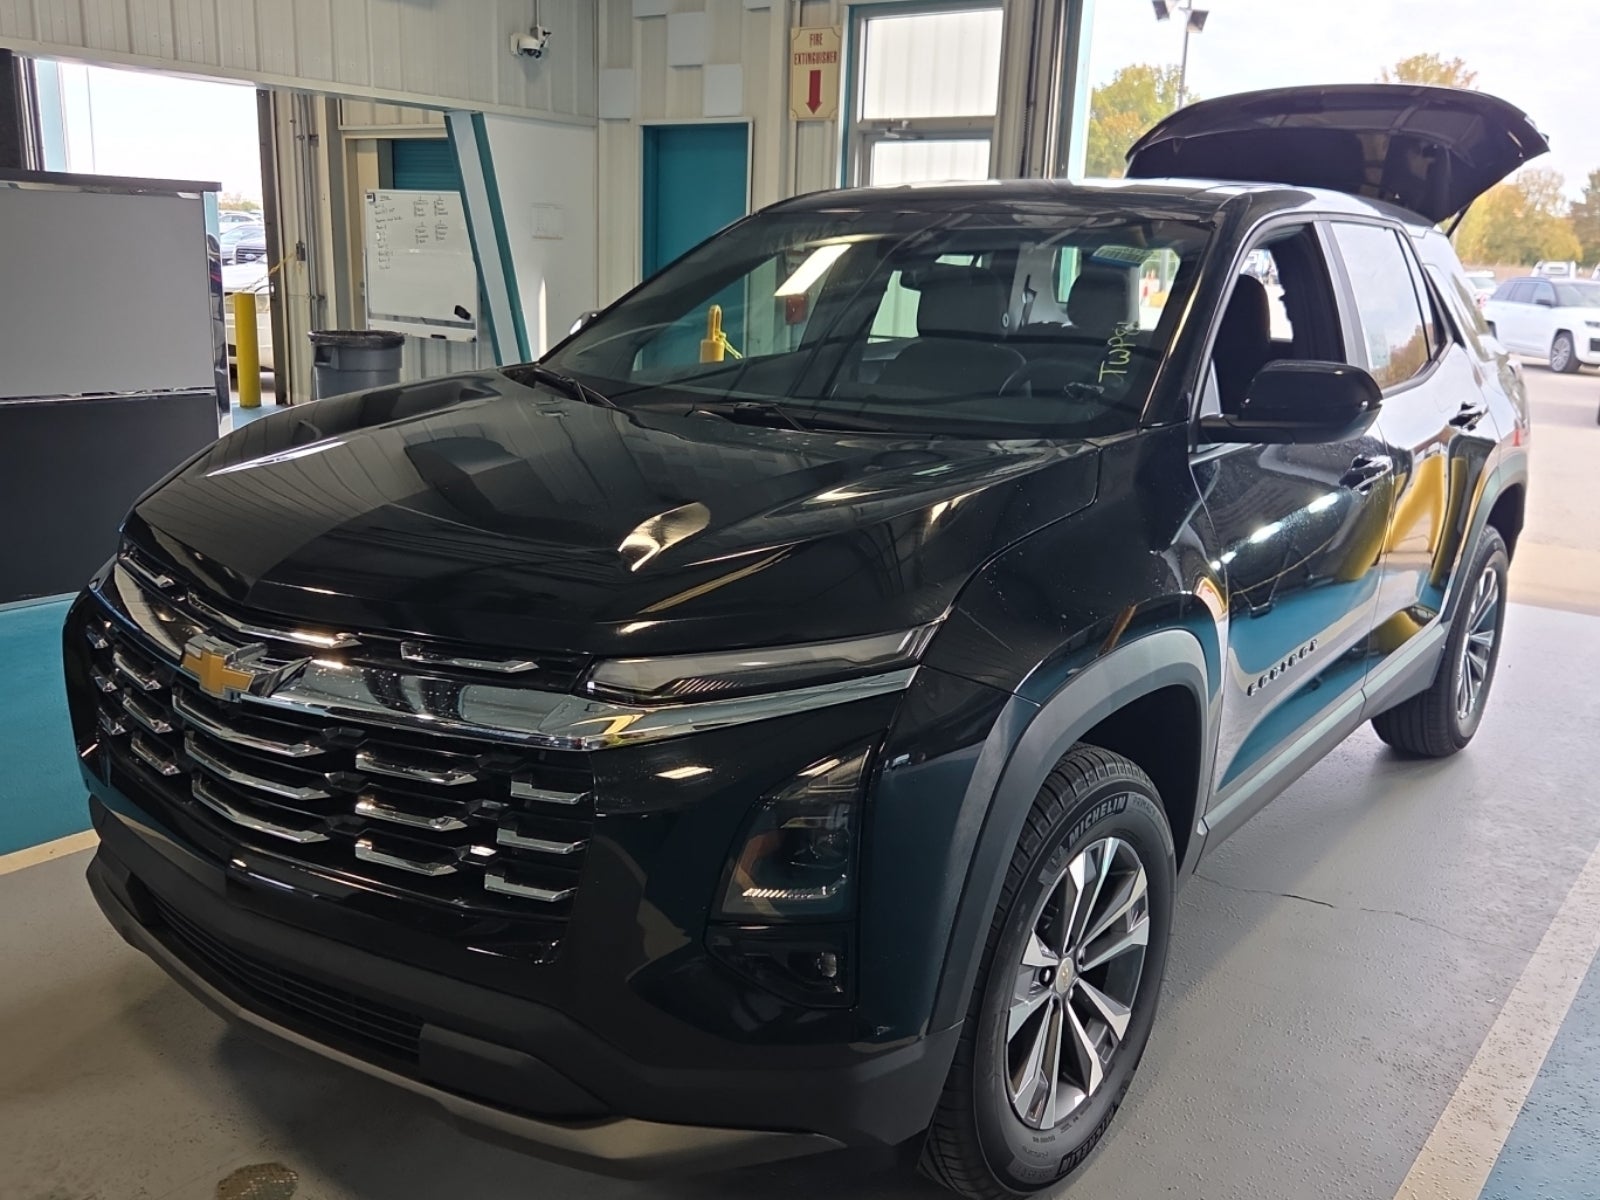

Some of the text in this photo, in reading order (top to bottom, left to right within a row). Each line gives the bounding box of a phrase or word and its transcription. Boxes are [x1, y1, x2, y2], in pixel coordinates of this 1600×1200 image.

[809, 33, 823, 47] FIRE
[794, 51, 837, 65] EXTINGUISHER
[1068, 795, 1127, 847] MICHELIN
